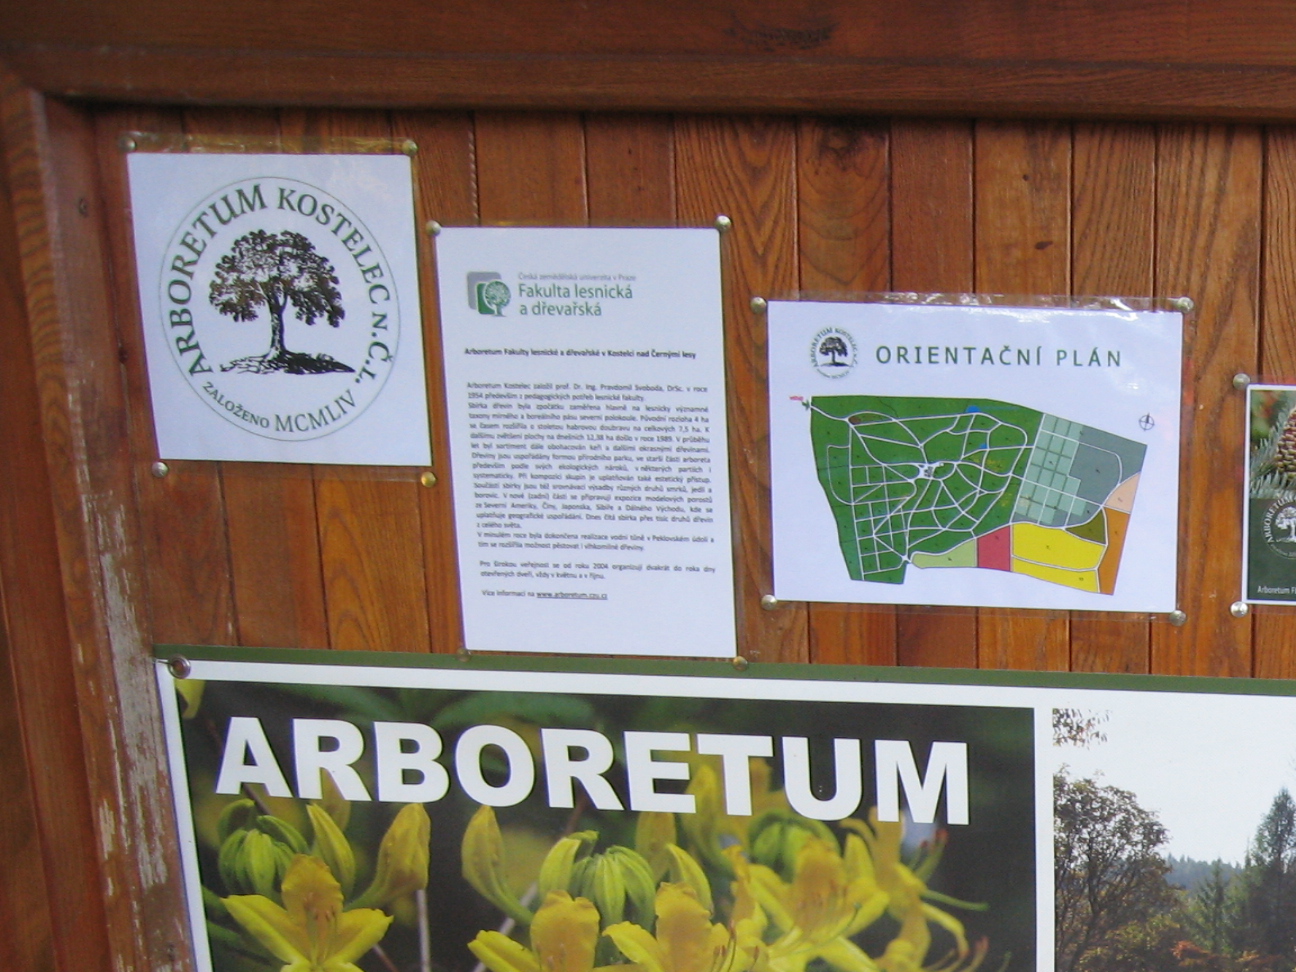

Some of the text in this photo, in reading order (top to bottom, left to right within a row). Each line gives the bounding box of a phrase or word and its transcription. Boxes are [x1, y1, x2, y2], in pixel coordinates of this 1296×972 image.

[168, 184, 268, 376] ARBORETUM
[278, 187, 390, 304] KOSTELEC
[518, 284, 633, 300] Fakulta lesnická
[520, 302, 602, 316] a dřevařská
[464, 348, 502, 356] Arboretum
[504, 349, 529, 357] Fakulty
[636, 350, 649, 358] nad
[651, 349, 680, 359] Černými
[682, 351, 696, 360] lesy
[876, 344, 1121, 368] ORIENTAČNÍ PLÁN
[202, 382, 356, 432] ZALOŽENO MCMLIV
[1258, 586, 1290, 594] Arboretum
[215, 716, 971, 825] ARBORETUM
